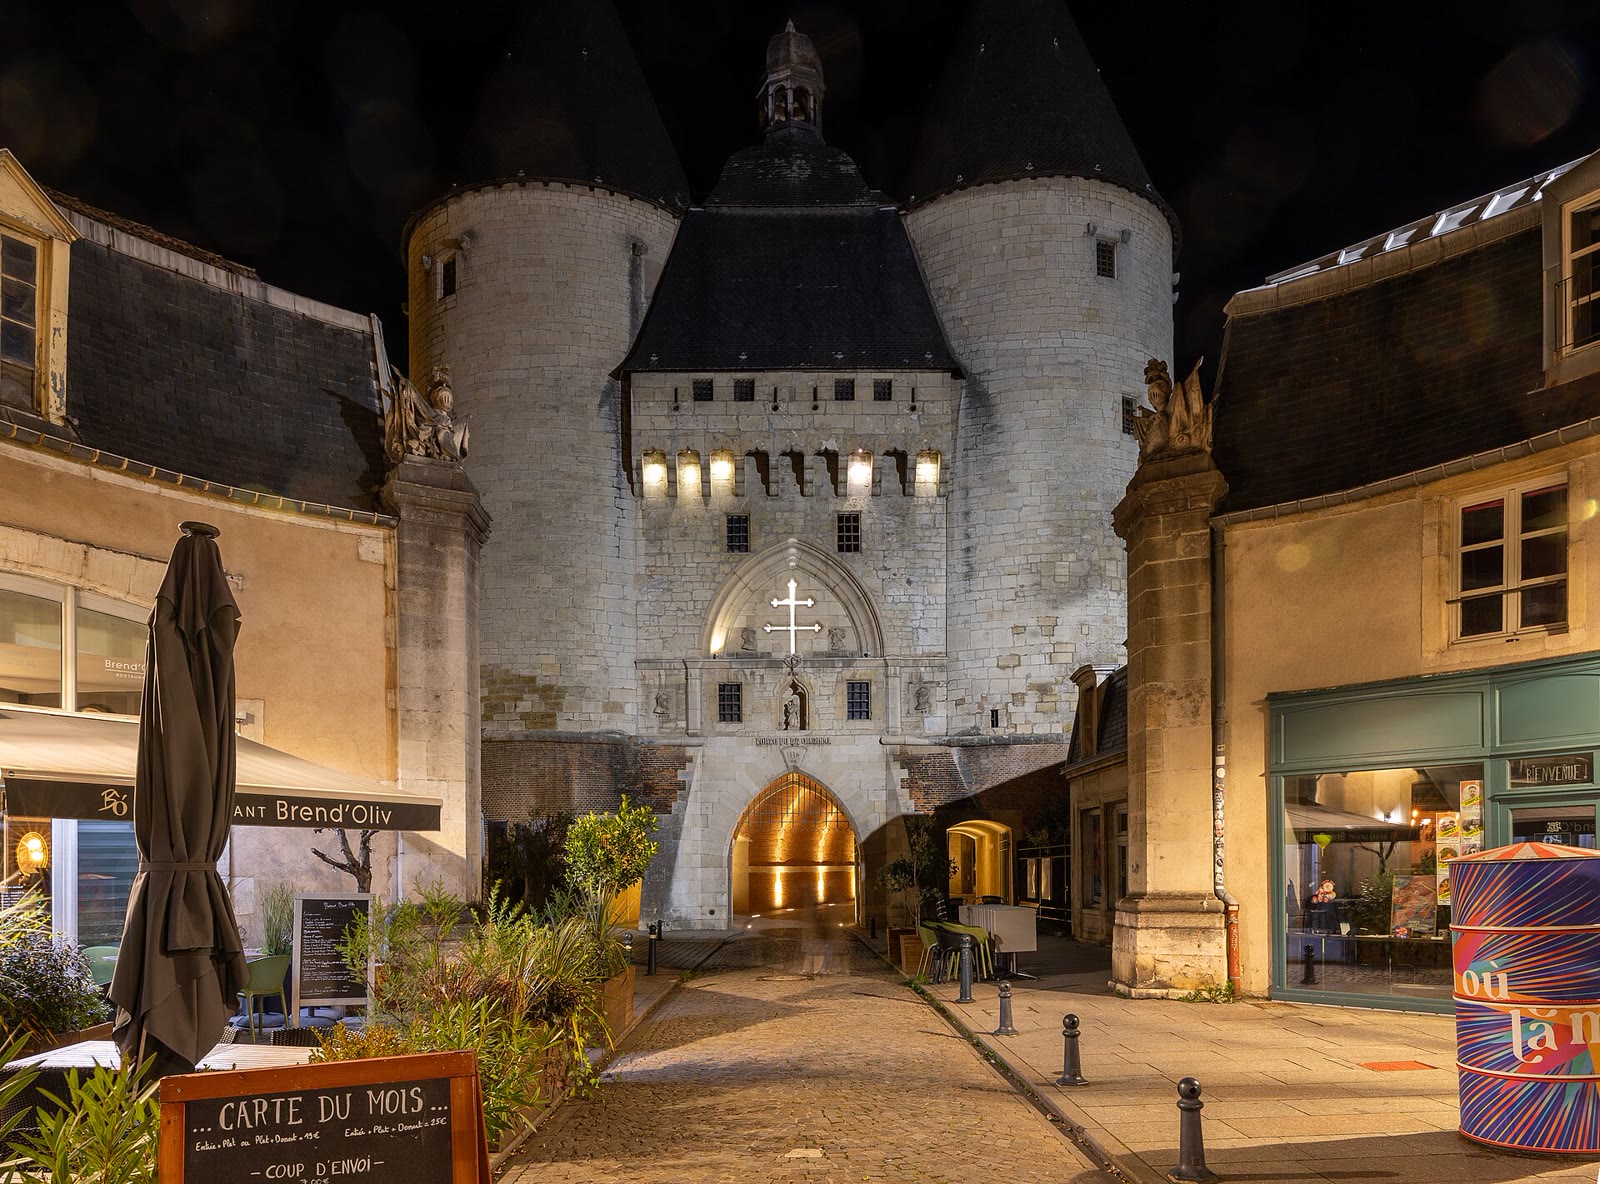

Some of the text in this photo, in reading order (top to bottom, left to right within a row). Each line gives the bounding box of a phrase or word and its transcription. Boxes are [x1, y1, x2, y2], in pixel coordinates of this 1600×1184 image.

[276, 800, 392, 825] Brend'Oliv
[218, 1096, 303, 1131] CARTE
[317, 1093, 352, 1123] DU
[366, 1086, 424, 1115] MOIS
[265, 1163, 305, 1179] COUP
